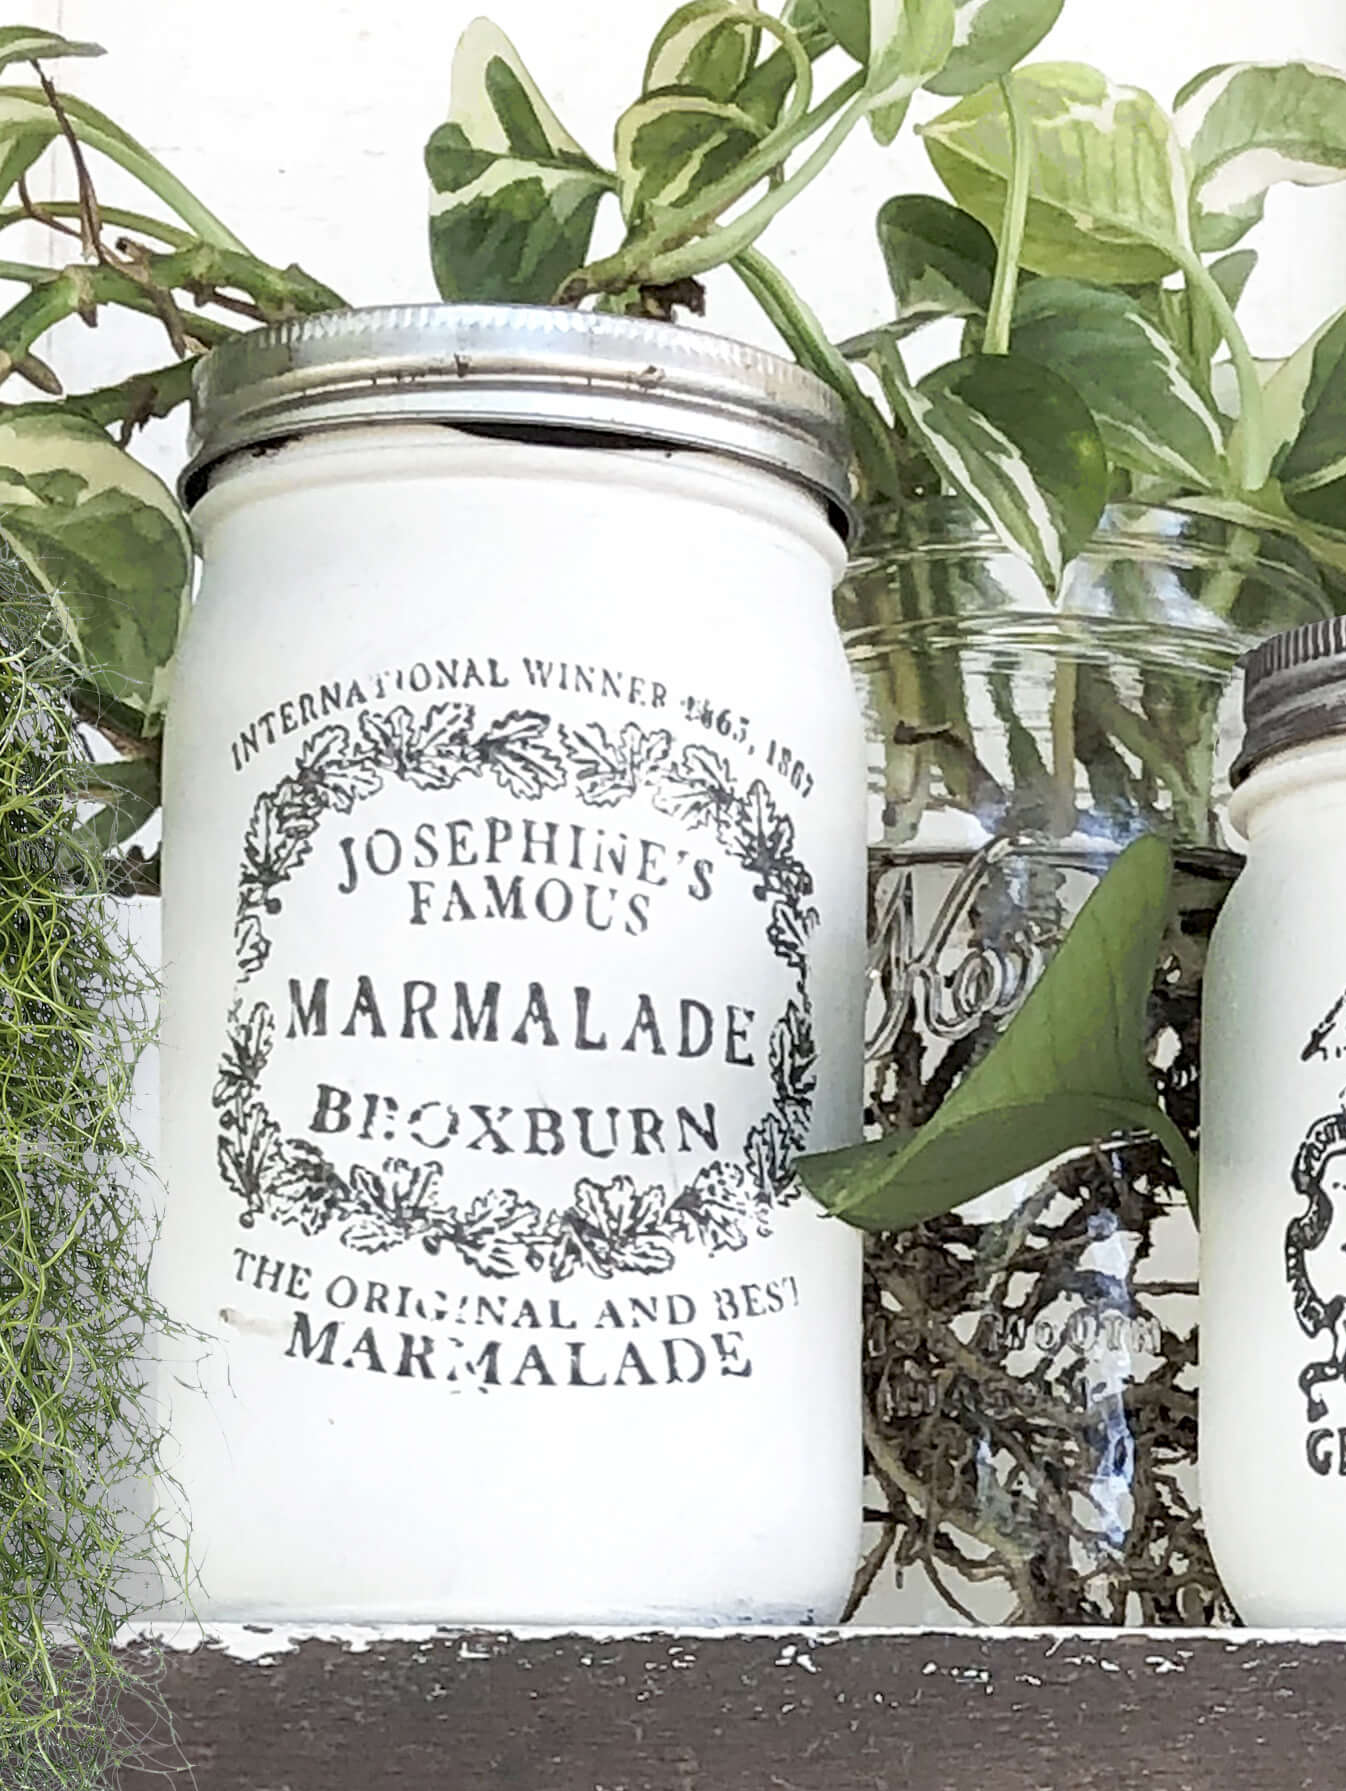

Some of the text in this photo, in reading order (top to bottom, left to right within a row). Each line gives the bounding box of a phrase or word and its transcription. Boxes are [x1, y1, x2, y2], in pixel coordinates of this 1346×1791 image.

[231, 657, 508, 771] INTERNATIONAL
[523, 657, 668, 709] WINNER
[337, 817, 715, 902] JOSEPHINE'S
[408, 873, 652, 936] FAMOUS
[285, 974, 756, 1067] MARMALADE
[309, 1083, 719, 1158] BROXBURN
[232, 1246, 801, 1328] THE ORIGINAL AND BEST
[284, 1310, 753, 1387] MARMALADE
